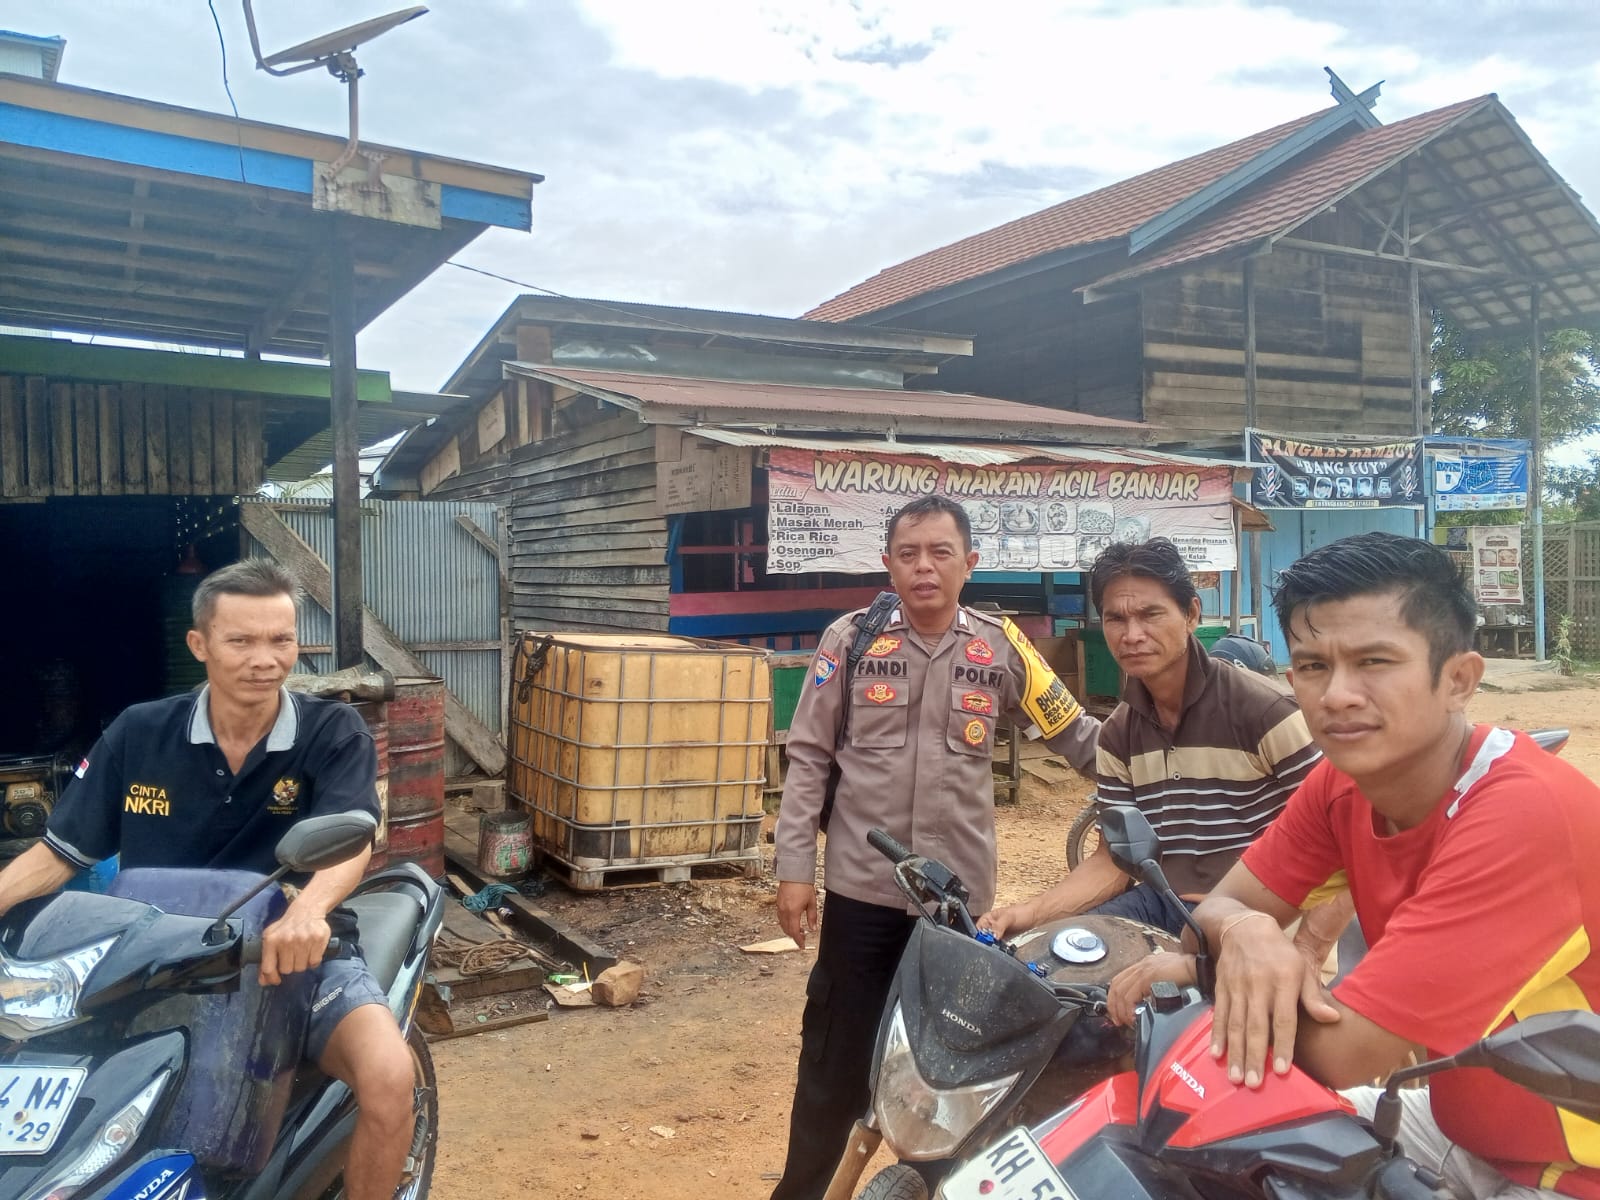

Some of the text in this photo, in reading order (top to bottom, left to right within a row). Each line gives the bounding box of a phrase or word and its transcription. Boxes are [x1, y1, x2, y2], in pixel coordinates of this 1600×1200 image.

[1261, 438, 1417, 459] PANGKAS RAMBUT
[814, 459, 1200, 500] WARUNG MAKAN ACIL BANJAR
[776, 503, 829, 515] Lalapan
[776, 517, 863, 529] Masak Merah
[776, 531, 838, 542] Rica Rica
[776, 545, 834, 557] Osengan
[776, 559, 801, 571] Sop
[858, 660, 908, 676] FANDI
[954, 666, 1003, 688] POLRI
[130, 784, 167, 799] CINTA
[124, 796, 170, 816] NKRI
[941, 1009, 982, 1035] HONDA
[1170, 1061, 1205, 1099] HONDA
[24, 1076, 70, 1109] NA
[986, 1134, 1036, 1185] KH
